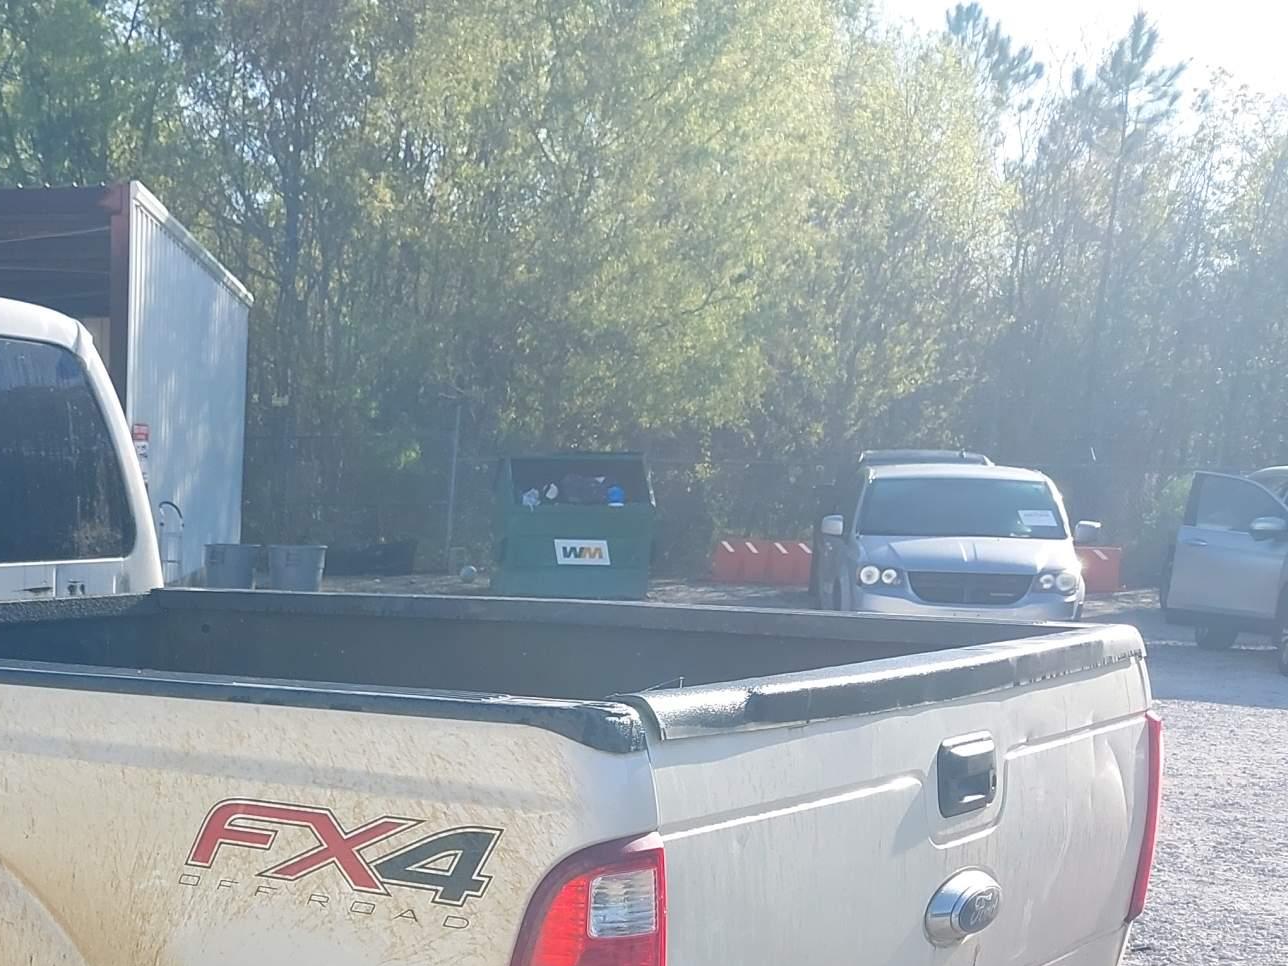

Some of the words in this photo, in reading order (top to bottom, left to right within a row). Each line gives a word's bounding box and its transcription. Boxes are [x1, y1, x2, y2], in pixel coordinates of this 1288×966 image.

[561, 546, 604, 559] WM
[185, 797, 505, 907] FX4
[178, 873, 278, 897] OFF
[306, 892, 470, 929] ROAD
